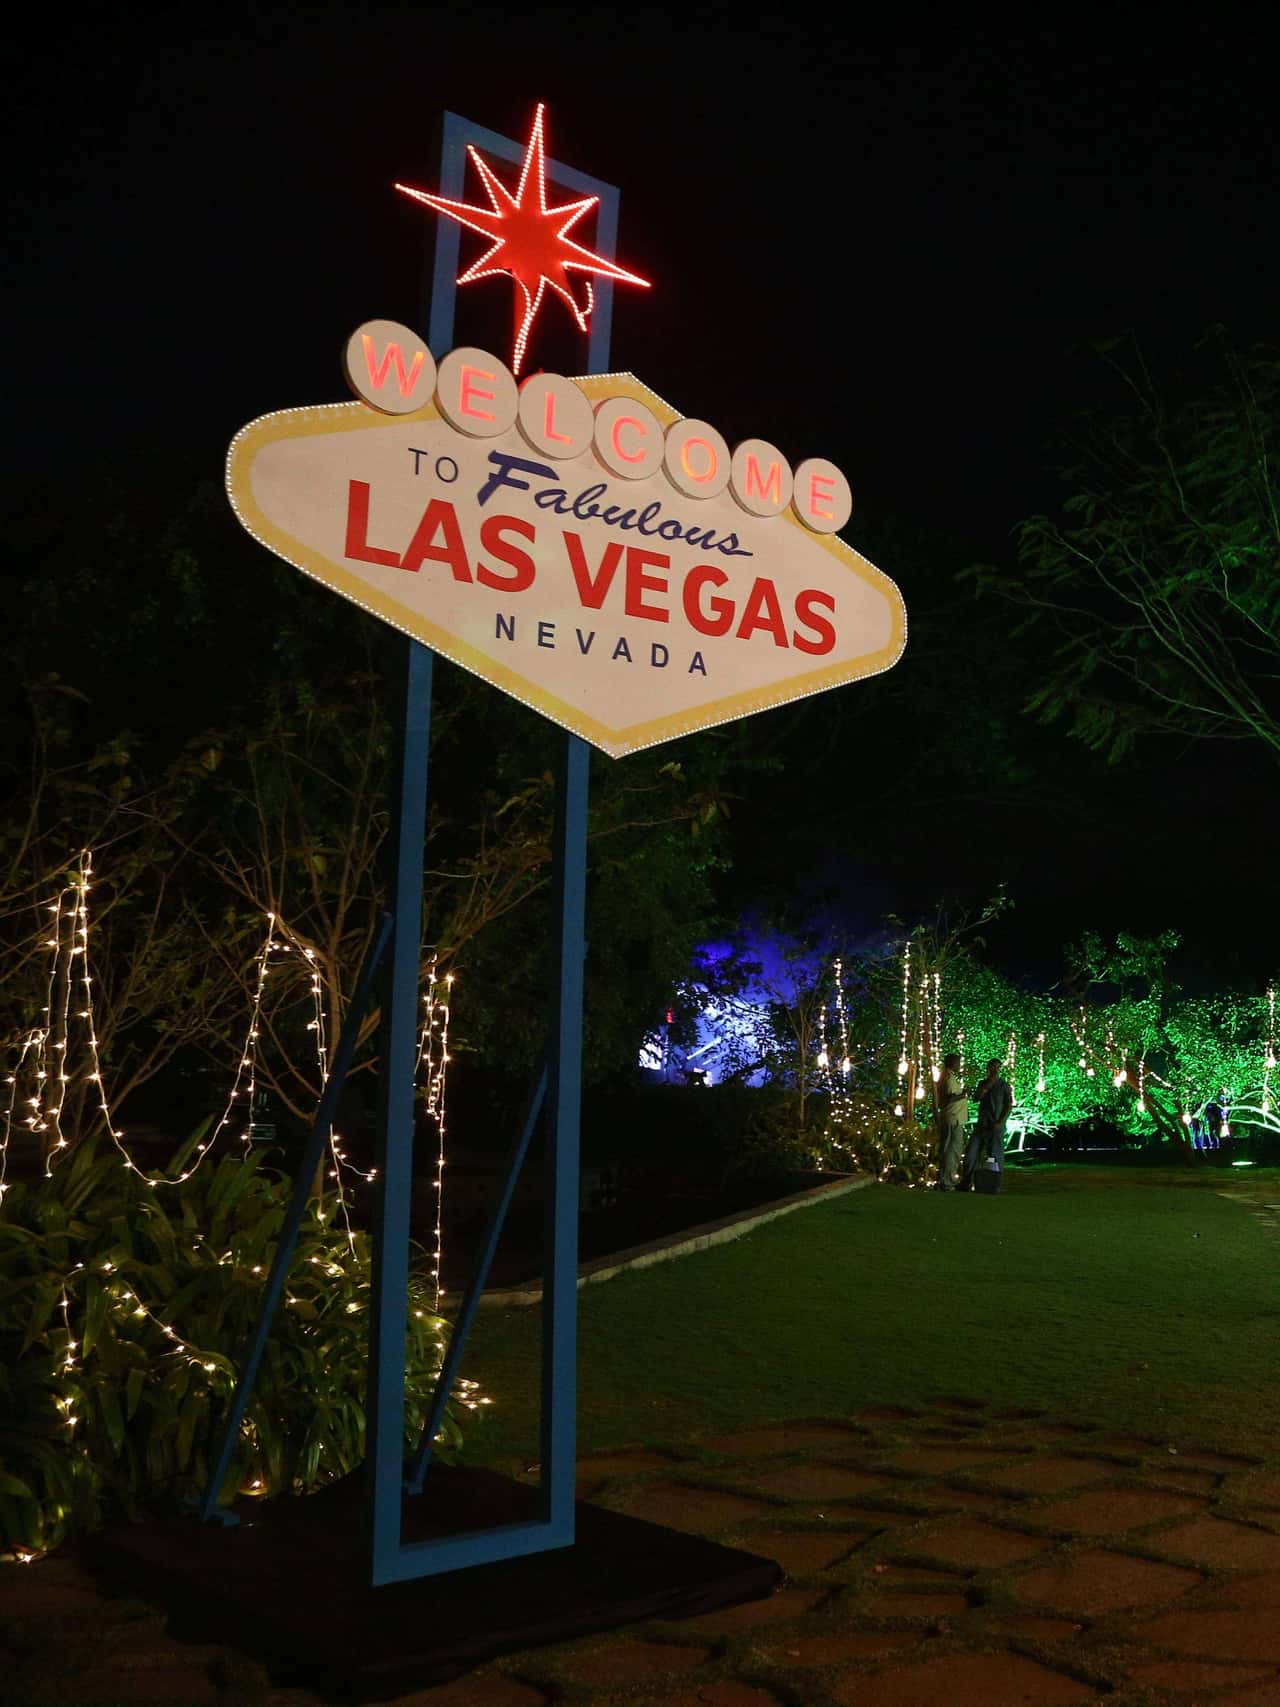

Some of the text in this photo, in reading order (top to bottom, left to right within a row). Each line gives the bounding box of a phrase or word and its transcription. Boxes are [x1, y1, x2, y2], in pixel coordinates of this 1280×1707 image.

[361, 334, 837, 521] WELCOME
[343, 478, 838, 656] LAS VEGAS
[407, 447, 754, 558] TO Fabulous
[495, 612, 708, 677] NEVADA
